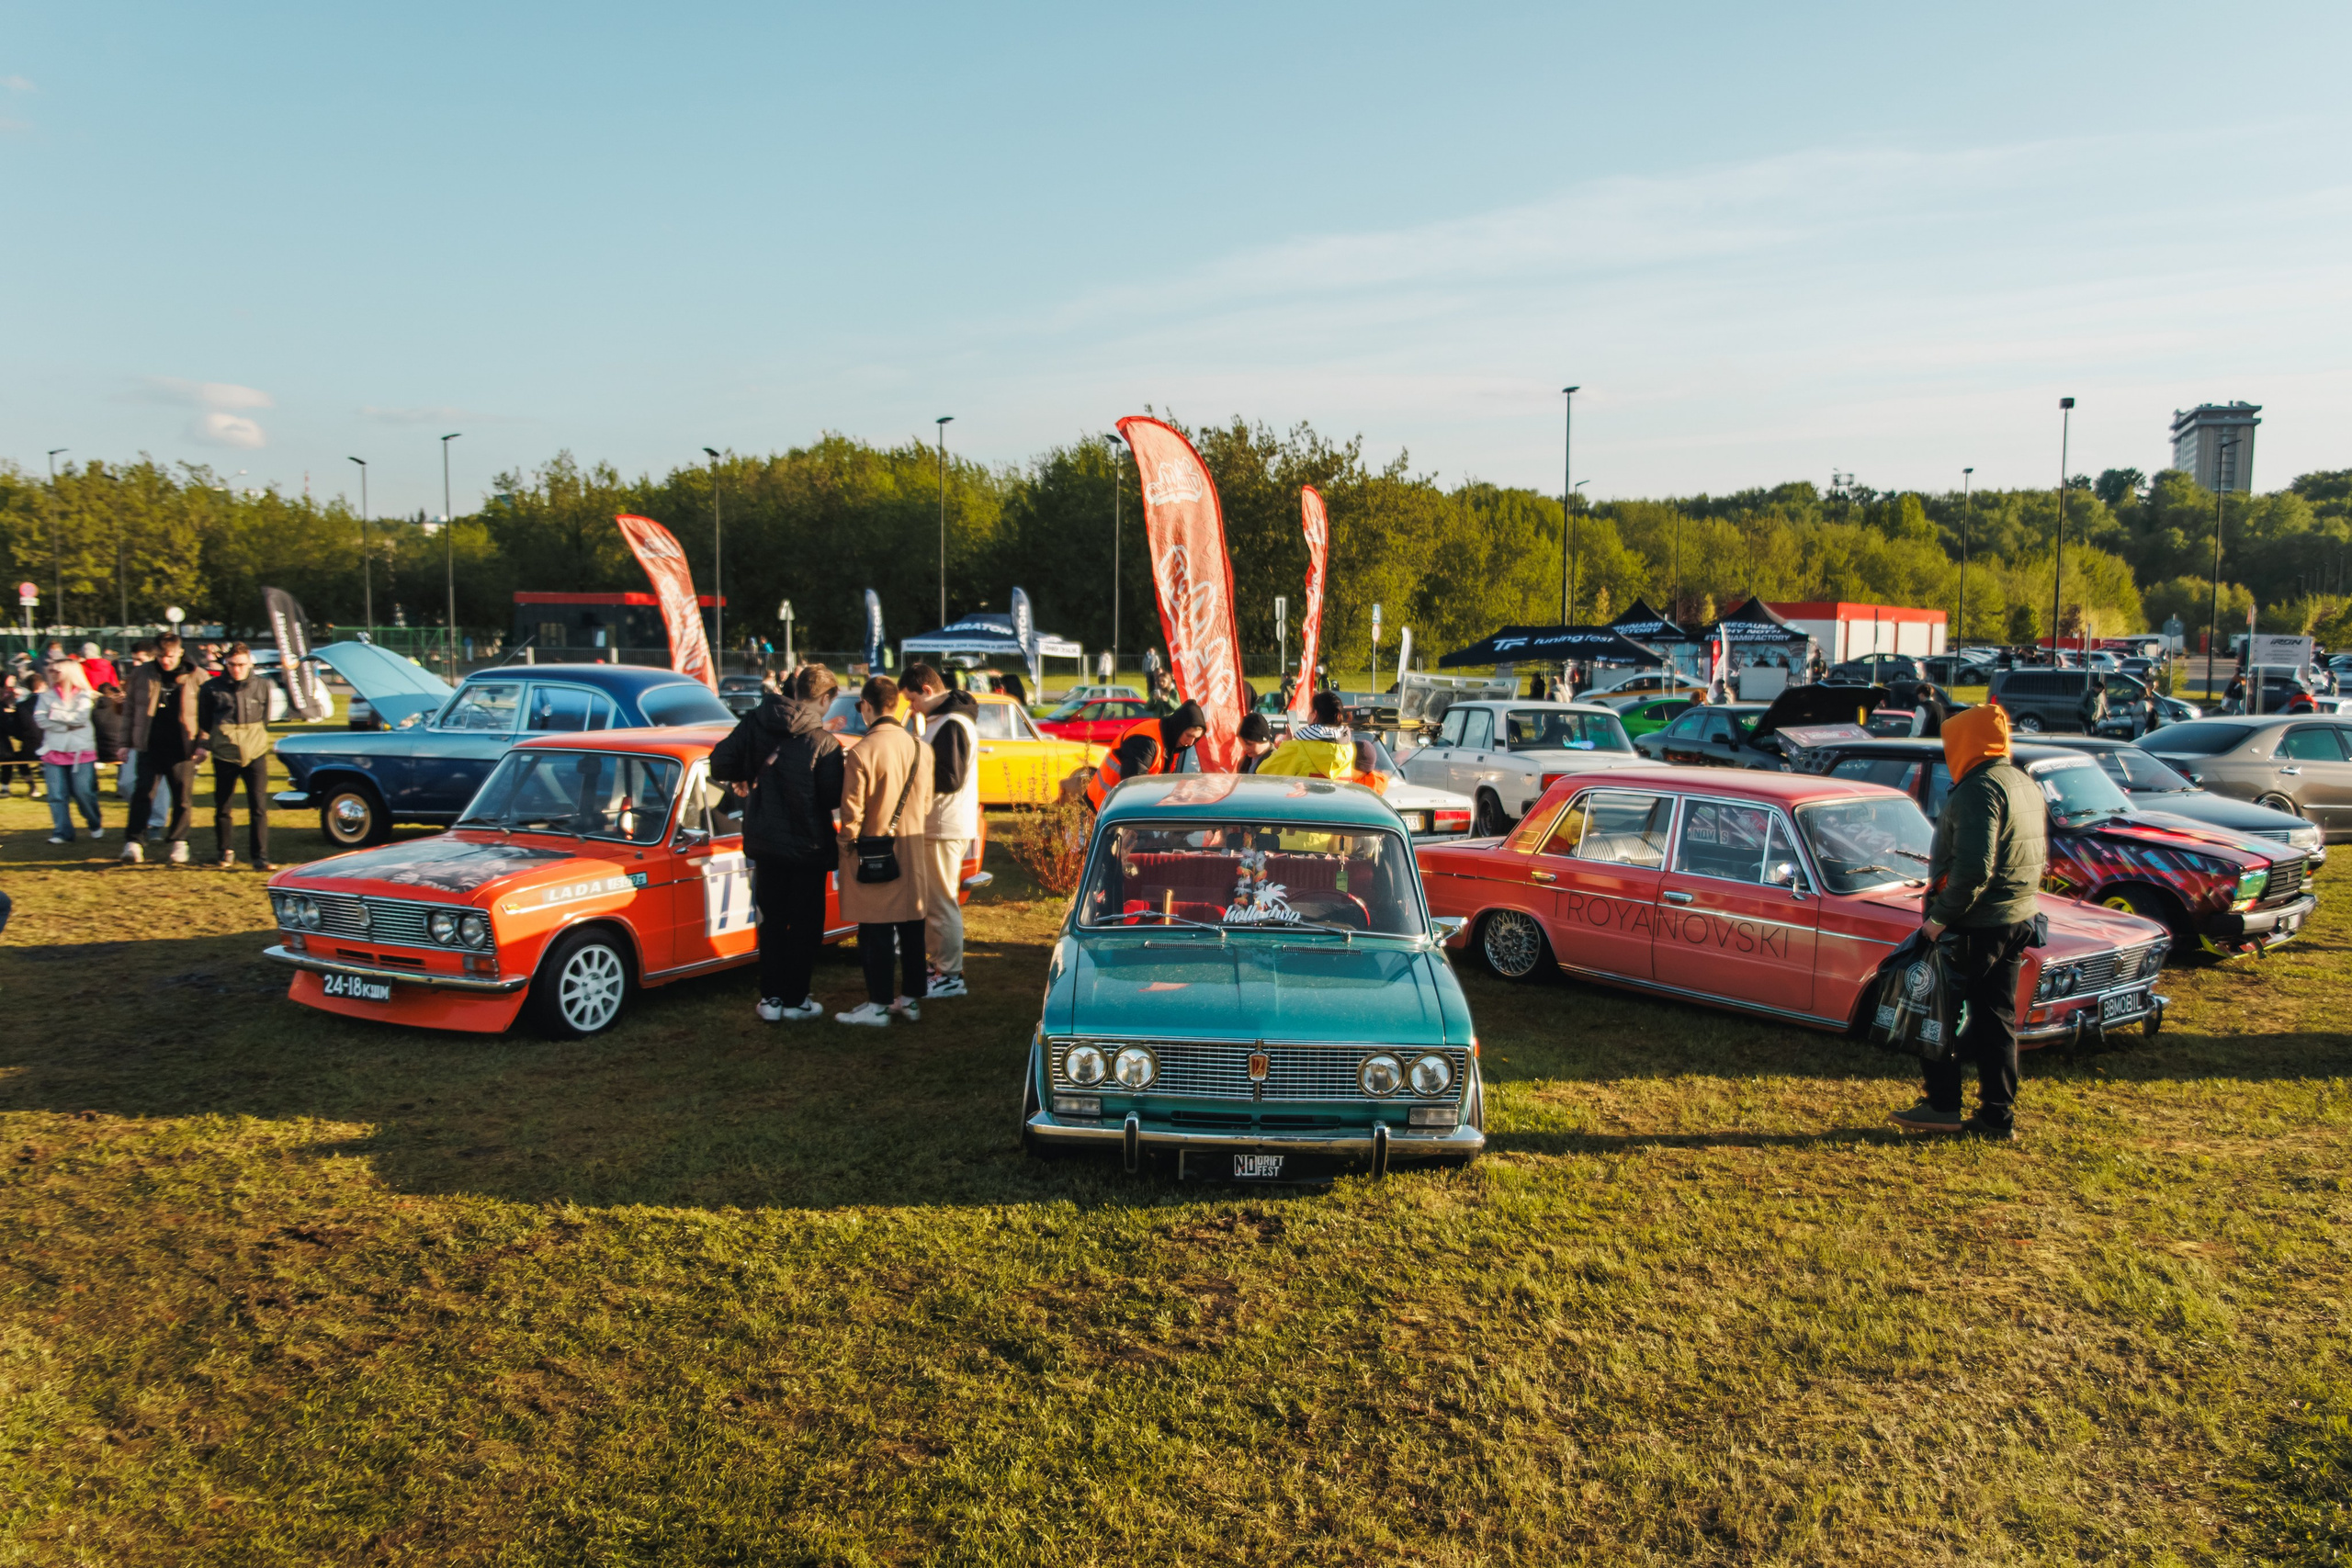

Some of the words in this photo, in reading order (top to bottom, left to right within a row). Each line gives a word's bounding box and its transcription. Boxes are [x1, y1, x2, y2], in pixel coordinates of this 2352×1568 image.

[944, 623, 1014, 636] LERATON
[1724, 622, 1776, 630] BECAUSE
[1704, 634, 1791, 642] #TSNAMIFACTORY
[548, 880, 602, 902] LADA
[1550, 889, 1790, 958] TROYANOVSKI
[2104, 992, 2143, 1019] BBMOBIL
[1257, 1155, 1284, 1167] DRIFT
[1257, 1165, 1280, 1178] FEST
